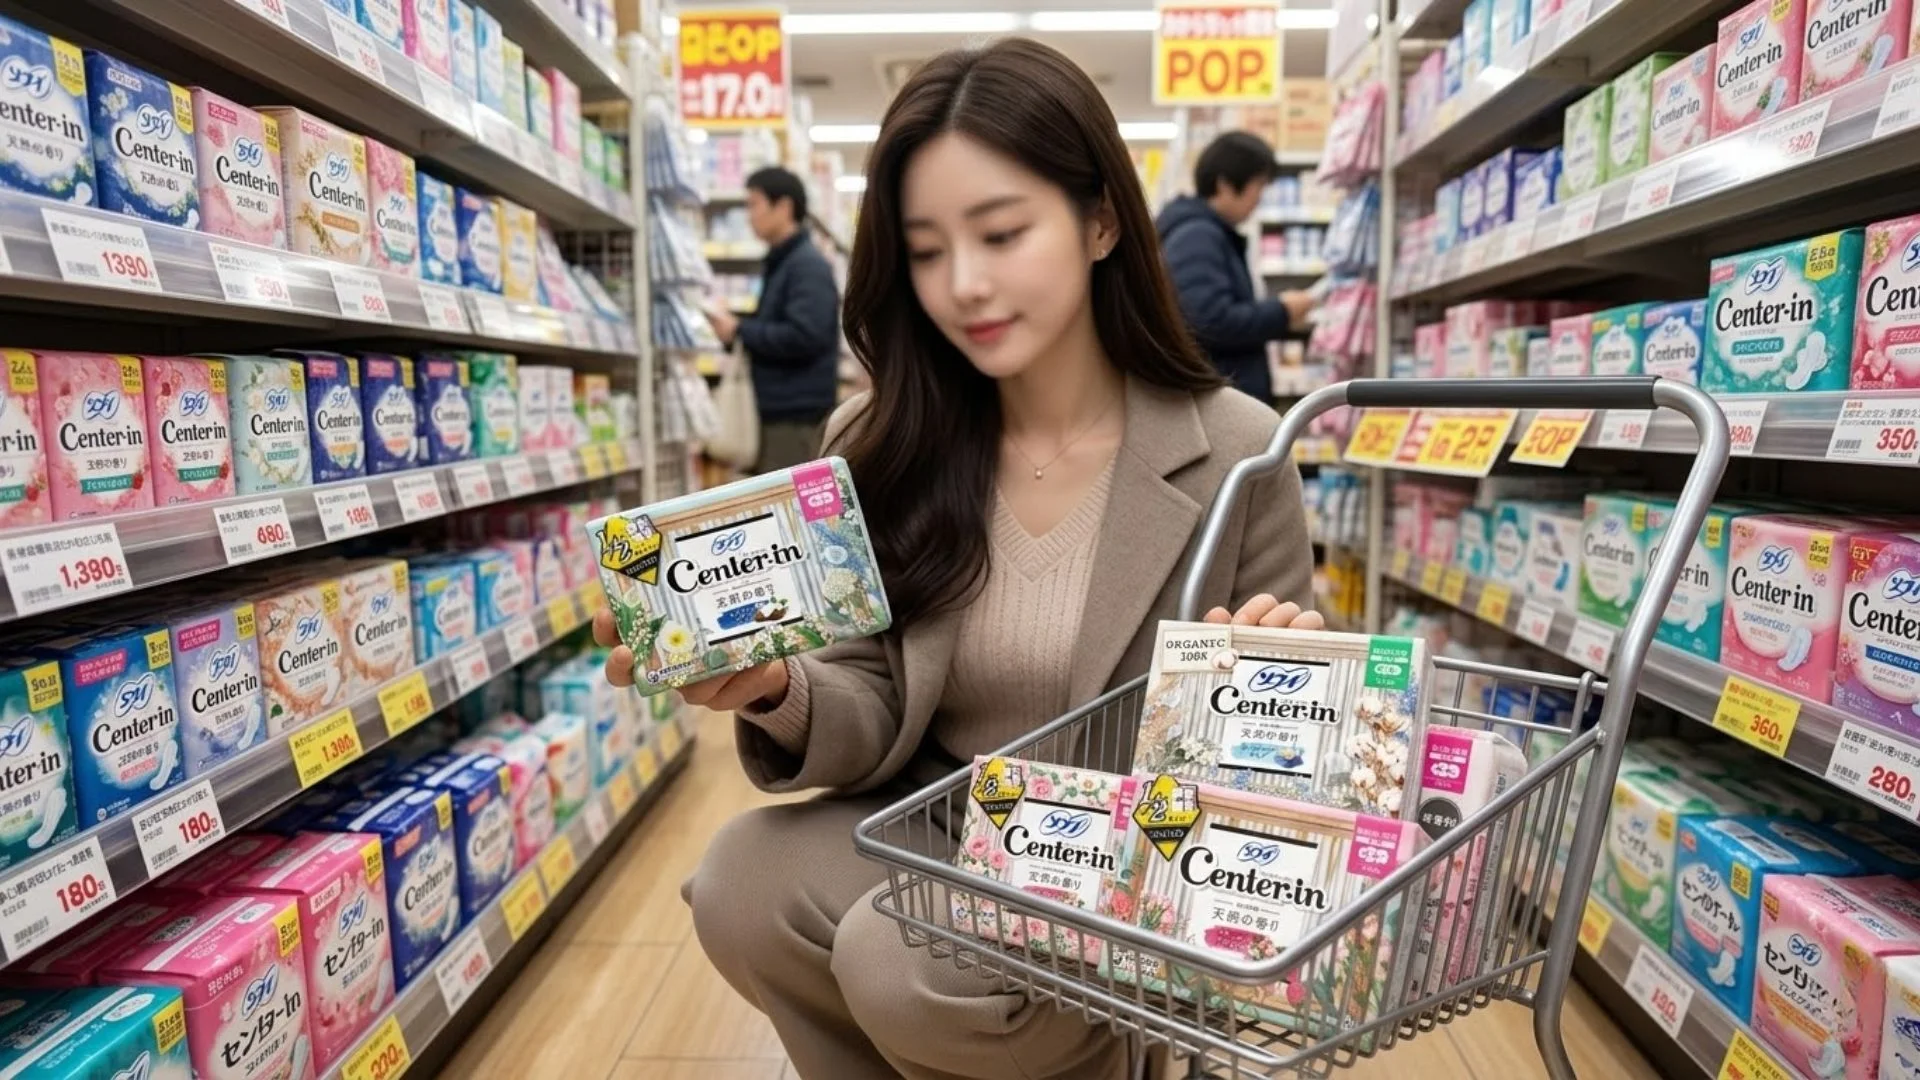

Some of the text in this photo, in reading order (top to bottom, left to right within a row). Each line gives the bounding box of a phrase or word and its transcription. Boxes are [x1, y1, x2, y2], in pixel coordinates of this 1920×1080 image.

[1167, 49, 1264, 94] POP
[1876, 428, 1915, 450] 350
[1867, 764, 1911, 801] 280
[179, 811, 211, 845] 180
[56, 873, 100, 913] 180
